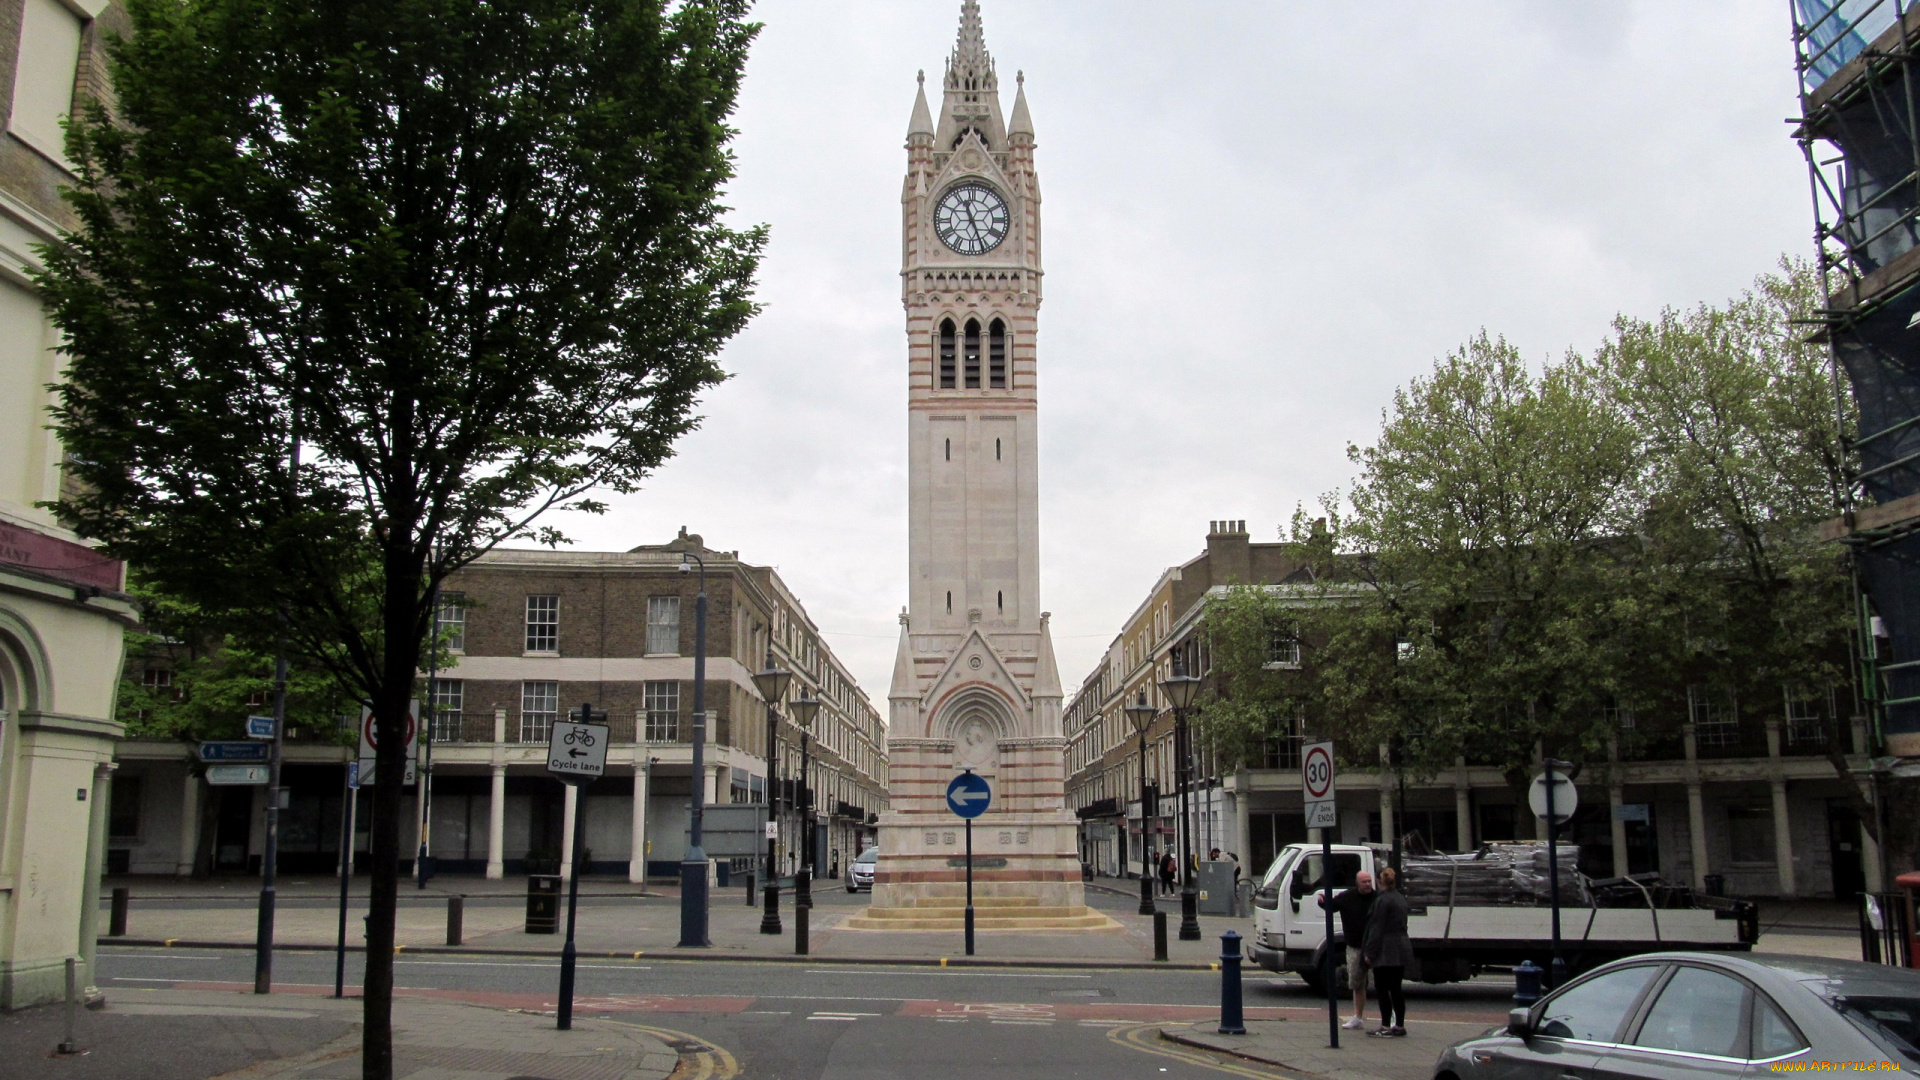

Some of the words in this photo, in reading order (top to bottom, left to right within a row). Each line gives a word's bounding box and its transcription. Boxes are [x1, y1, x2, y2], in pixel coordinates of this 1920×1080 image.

[552, 759, 577, 769] Cycle
[581, 762, 600, 771] lane
[1309, 762, 1327, 783] 30
[1318, 814, 1334, 822] ENDS
